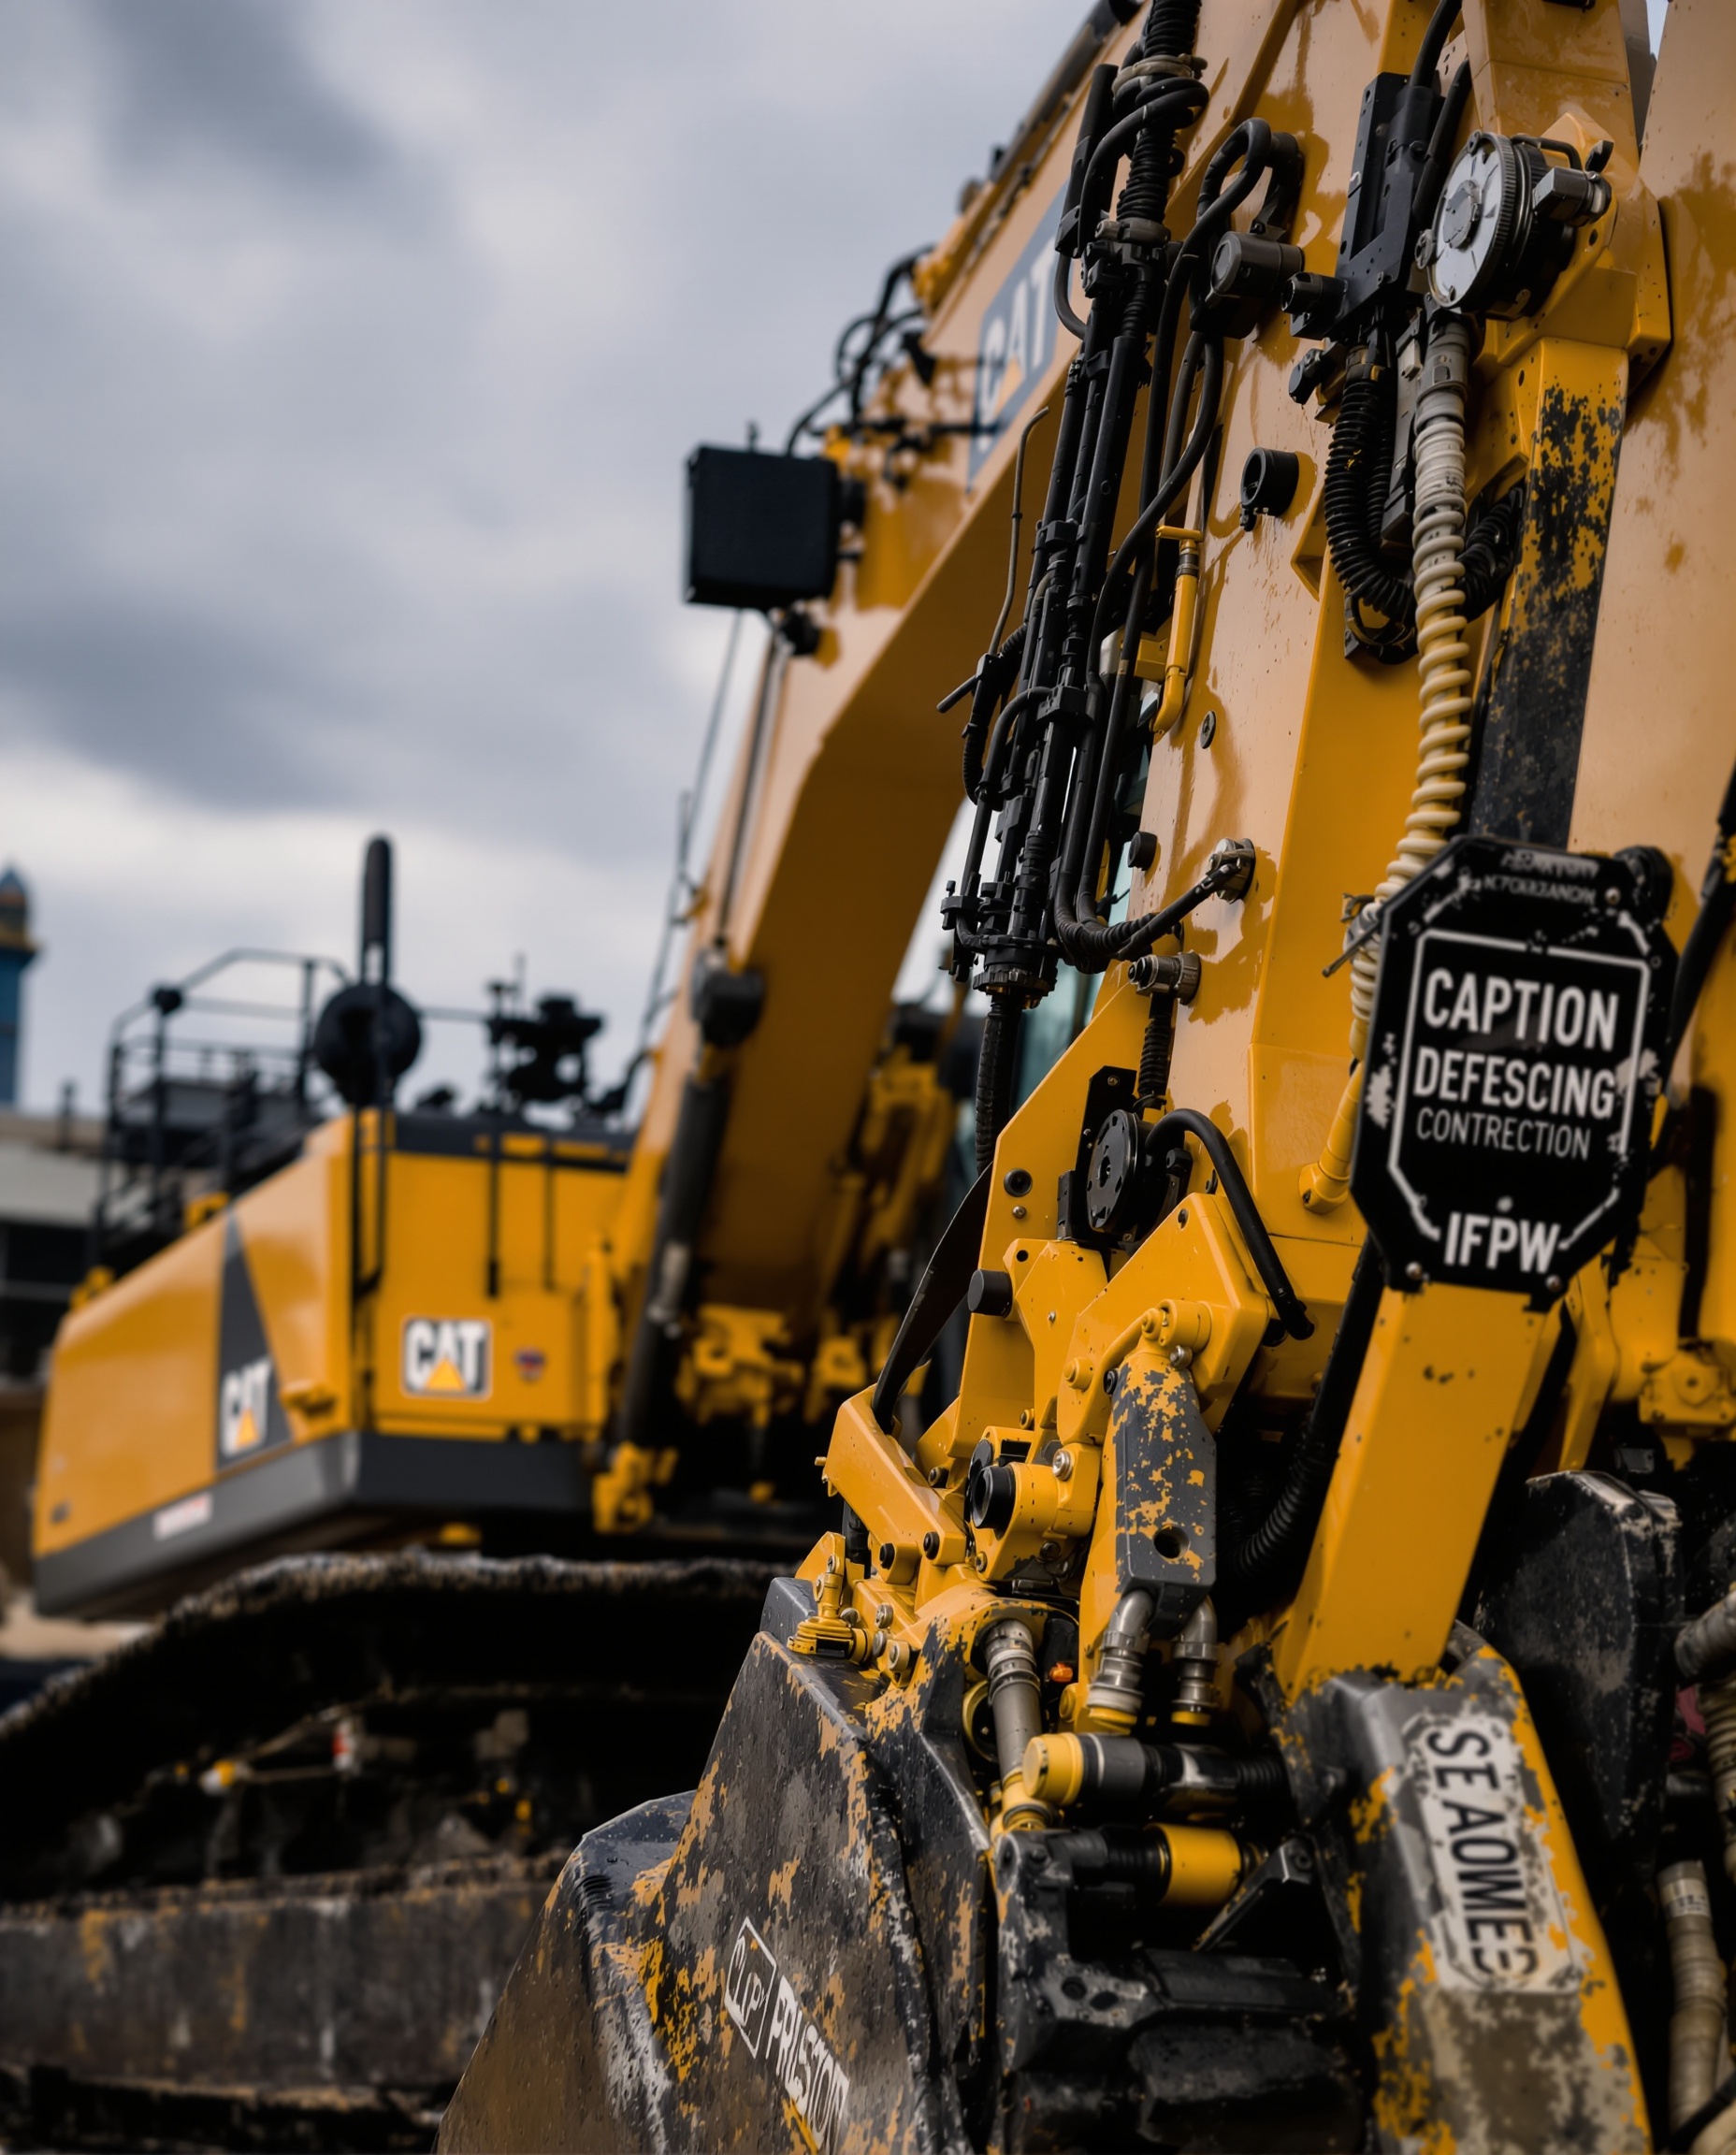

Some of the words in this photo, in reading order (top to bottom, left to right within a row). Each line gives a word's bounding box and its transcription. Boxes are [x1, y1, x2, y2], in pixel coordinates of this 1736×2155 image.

[978, 238, 1055, 453] CAT
[1424, 967, 1619, 1051] CAPTION
[1413, 1046, 1615, 1120] DEFESCING
[1416, 1106, 1591, 1161] CONTRECTION
[1444, 1212, 1560, 1274] IFPW
[407, 1320, 487, 1392] CAT
